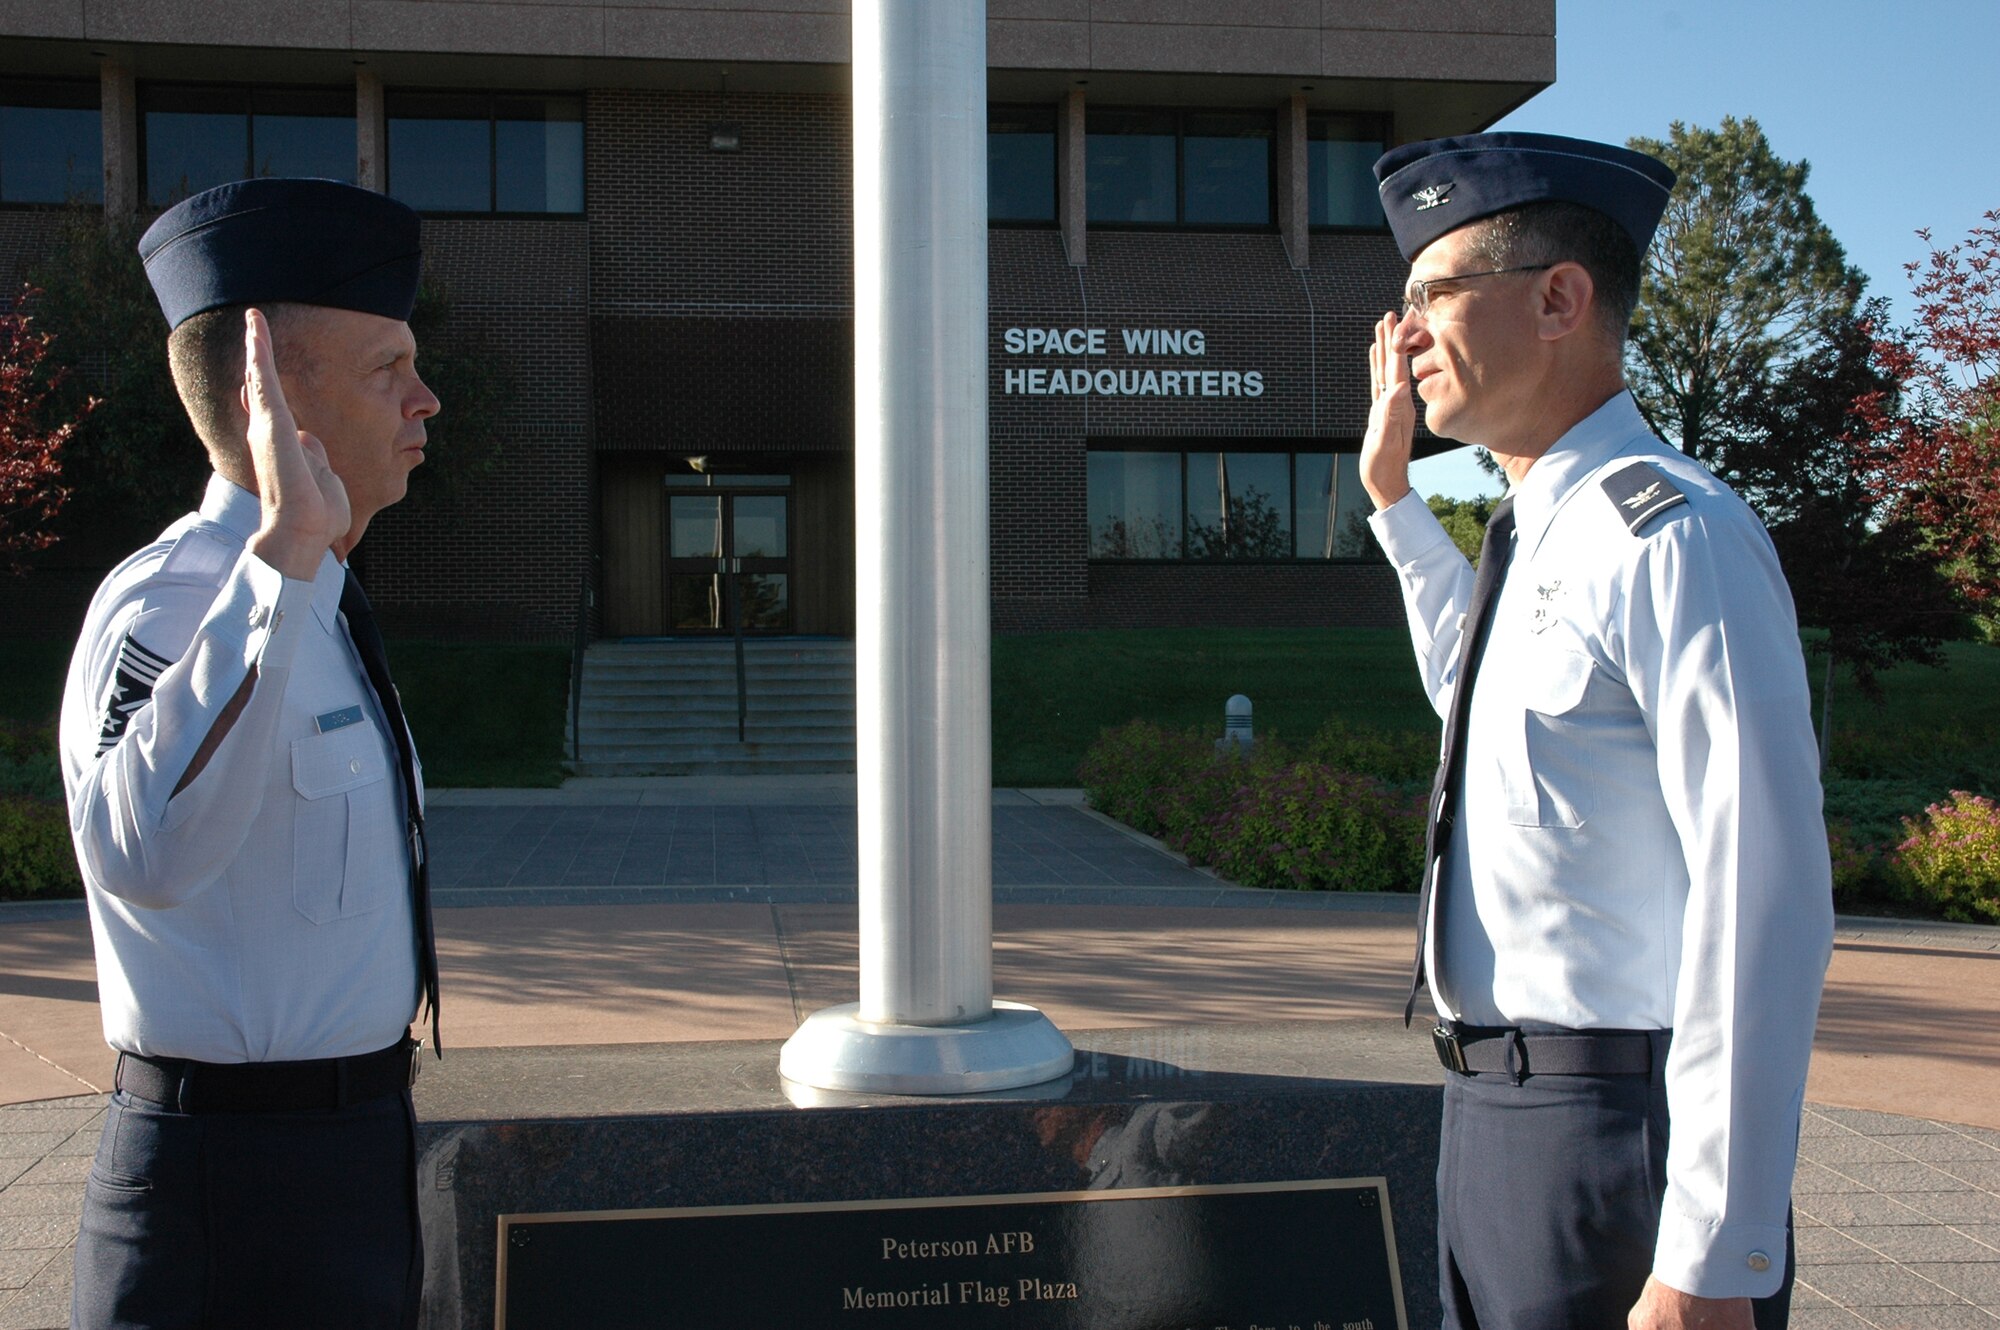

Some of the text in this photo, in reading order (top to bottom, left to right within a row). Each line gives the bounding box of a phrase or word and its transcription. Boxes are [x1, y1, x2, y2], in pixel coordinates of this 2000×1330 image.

[1004, 328, 1205, 355] SPACE WING
[1004, 369, 1264, 396] HEADQUARTERS
[881, 1232, 1035, 1260] Peterson AFB
[842, 1278, 1078, 1310] Memorial Flag Plaza
[1342, 1317, 1374, 1330] south
